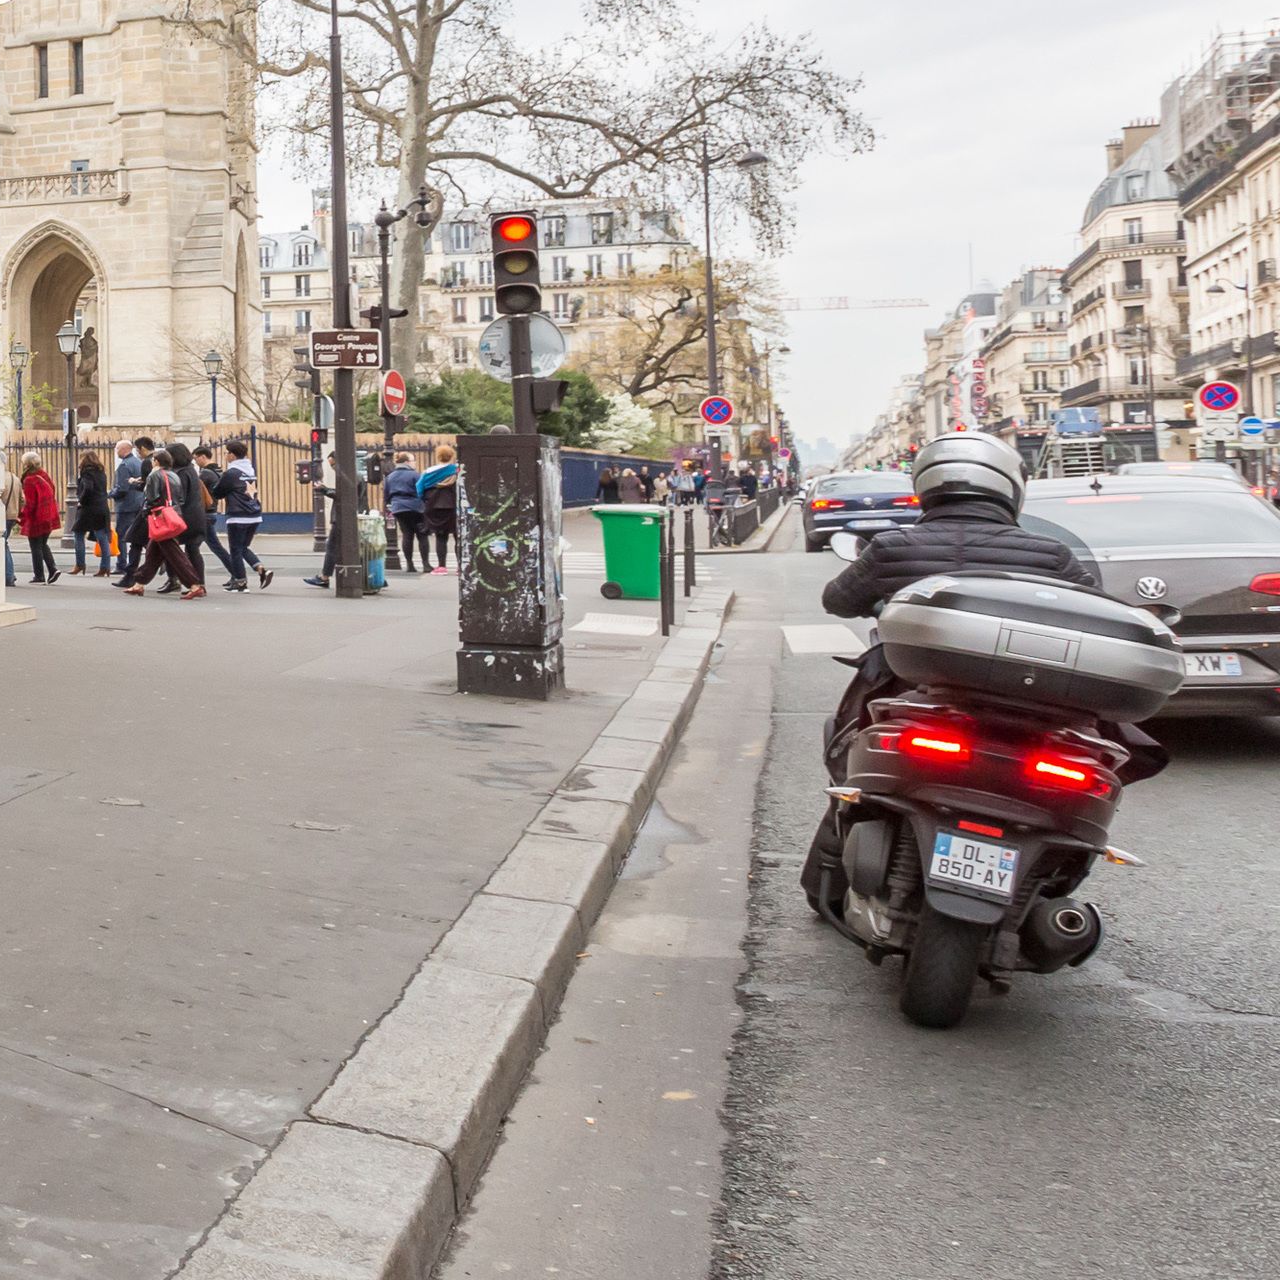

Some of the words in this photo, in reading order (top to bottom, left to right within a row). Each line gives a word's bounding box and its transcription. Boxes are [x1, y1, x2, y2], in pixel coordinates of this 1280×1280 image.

[314, 342, 346, 351] Georges
[347, 342, 378, 351] Pompidou
[1000, 860, 1013, 870] 75
[938, 858, 1008, 888] 850-AY
